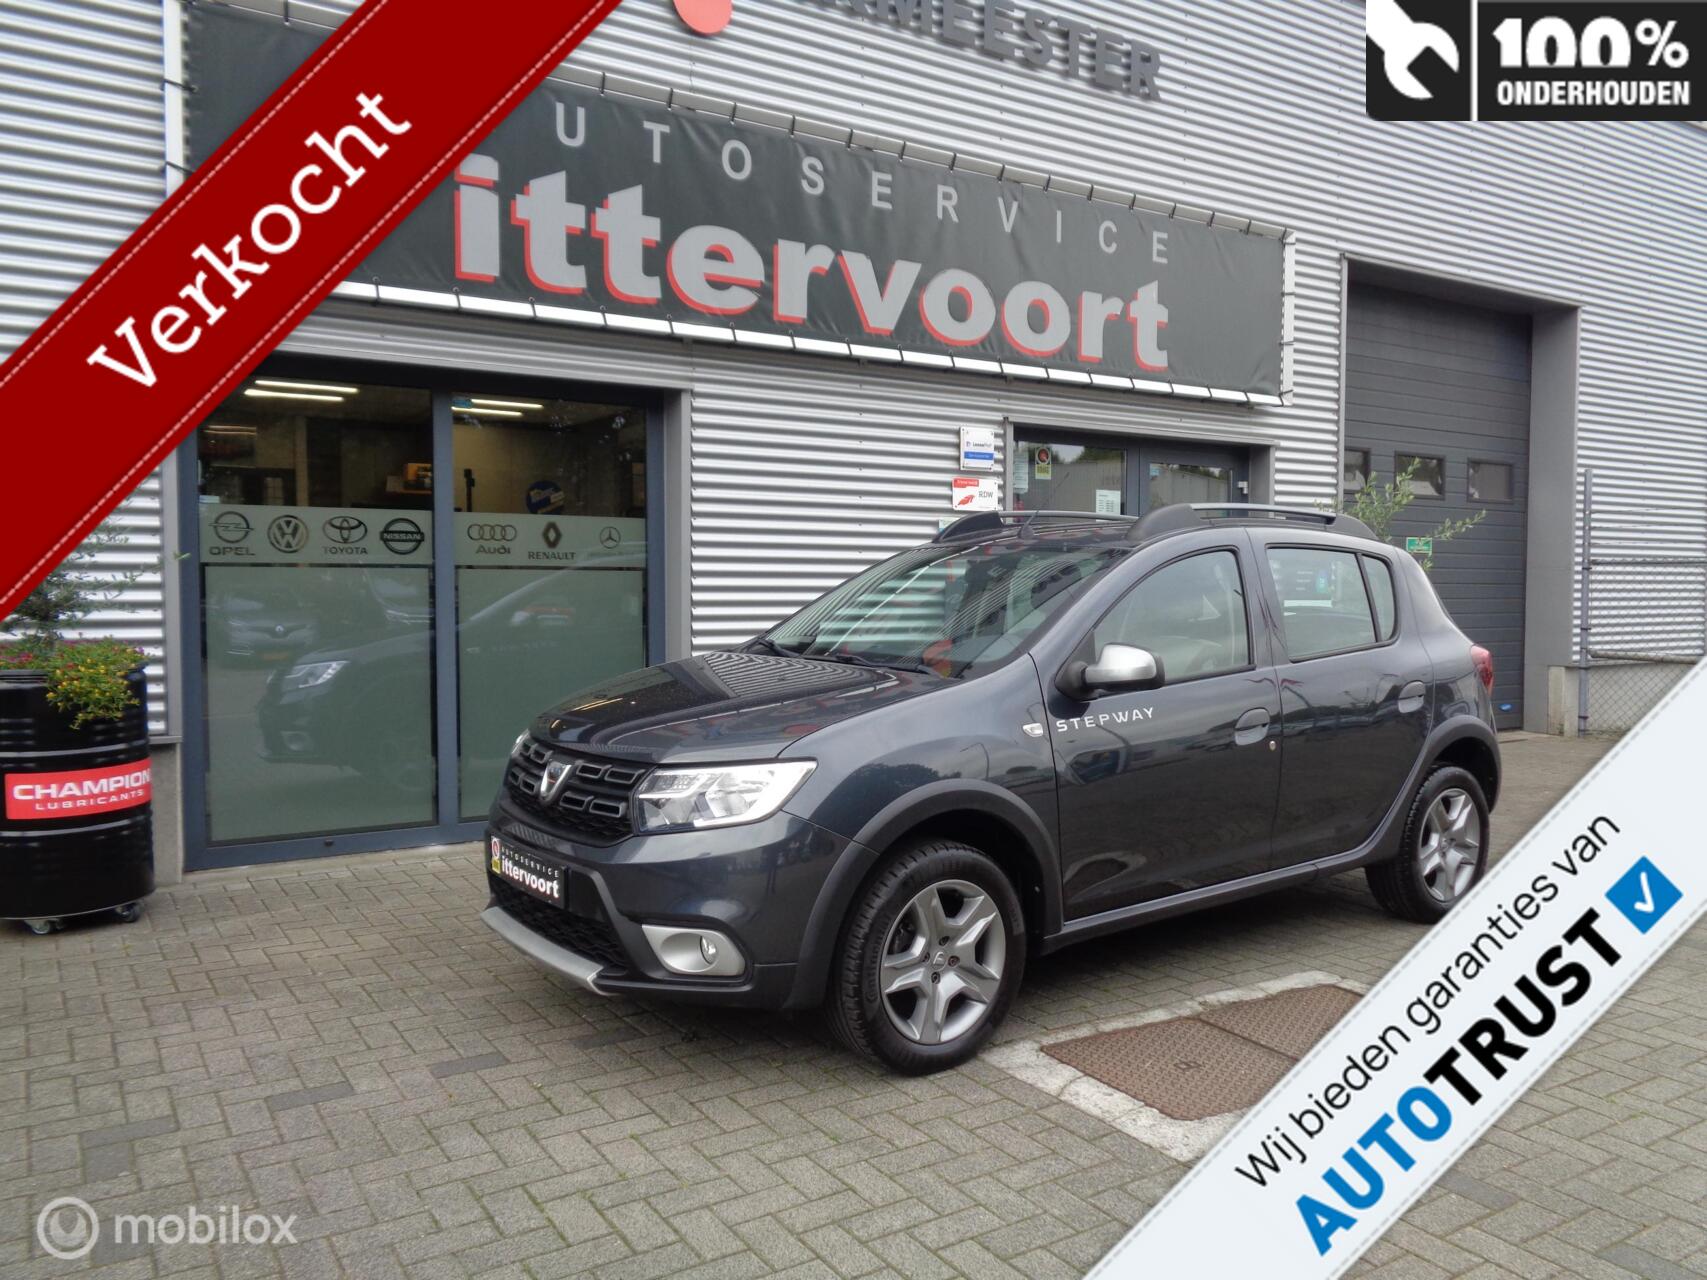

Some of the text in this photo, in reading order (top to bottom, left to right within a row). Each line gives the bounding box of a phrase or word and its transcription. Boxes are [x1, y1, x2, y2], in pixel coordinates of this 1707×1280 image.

[822, 0, 1161, 99] EESTER
[555, 101, 1169, 265] UTOSERVICE
[454, 152, 1170, 372] ittervoort
[978, 490, 994, 499] RDW
[382, 532, 422, 542] NISSAN
[208, 546, 255, 556] OPEL
[323, 545, 368, 555] TOYOTA
[475, 544, 511, 555] Audi
[527, 551, 577, 561] RENAULT
[1055, 707, 1154, 732] STEPWAY
[13, 767, 151, 800] CHAMPION
[35, 788, 145, 811] LUBRICANTS
[501, 855, 560, 898] ittervoort
